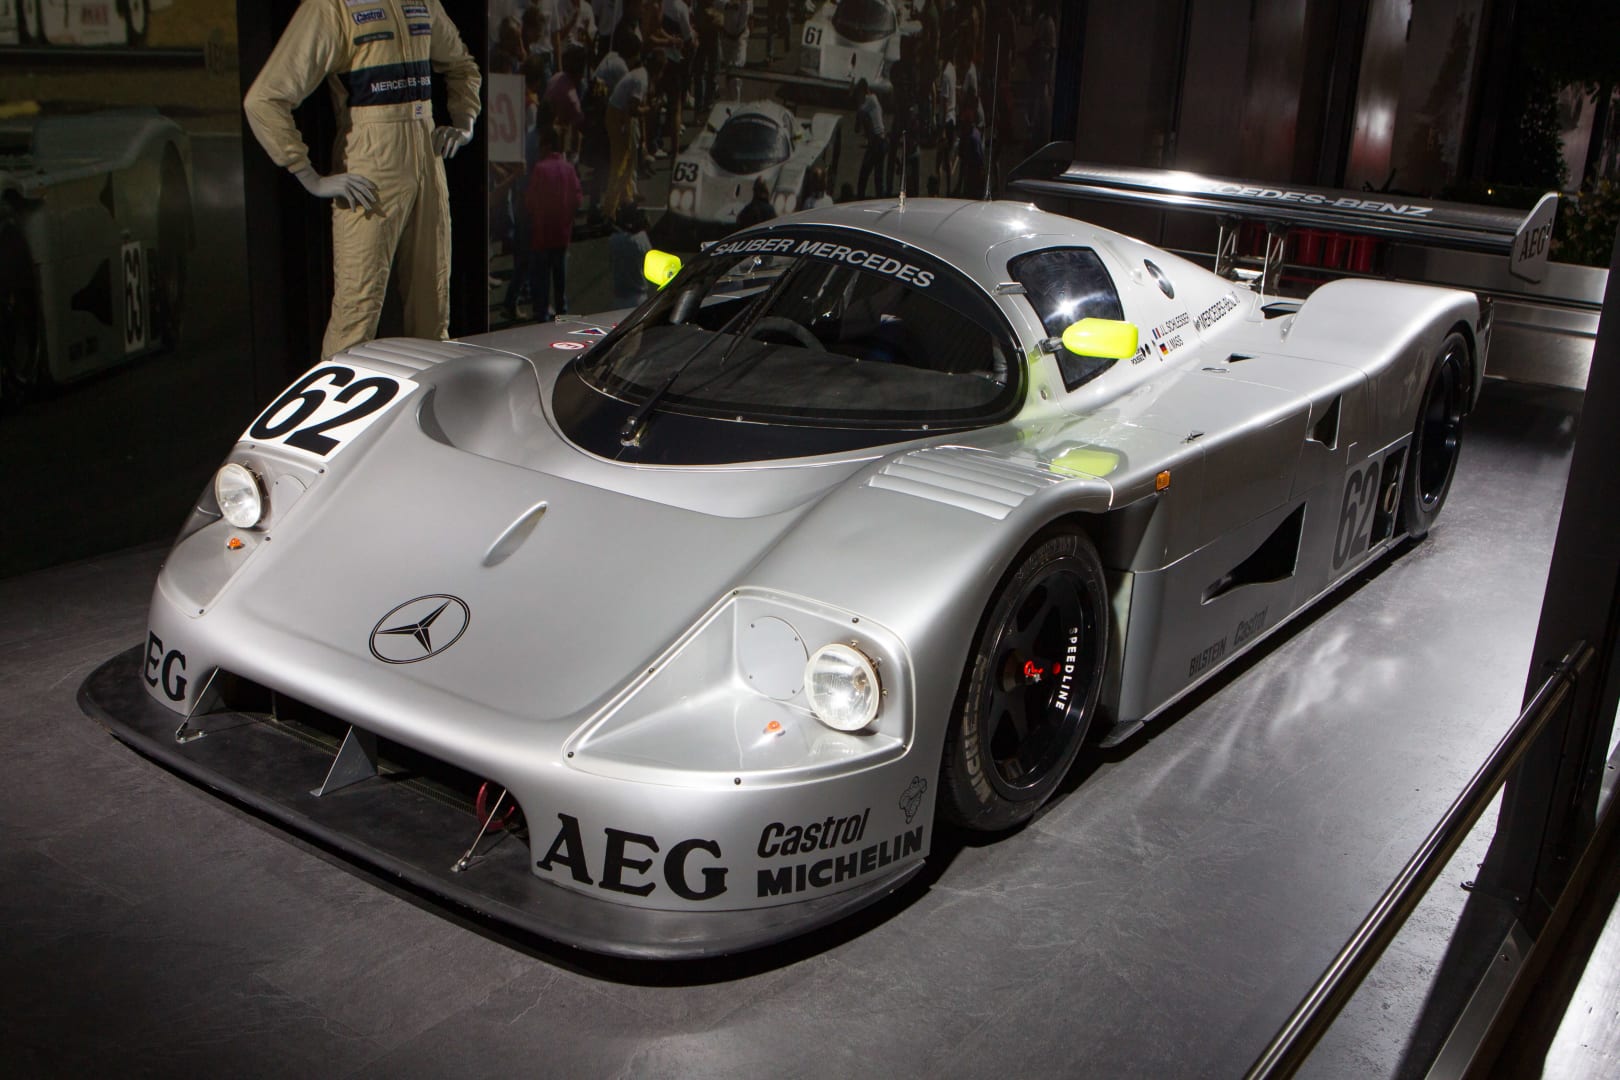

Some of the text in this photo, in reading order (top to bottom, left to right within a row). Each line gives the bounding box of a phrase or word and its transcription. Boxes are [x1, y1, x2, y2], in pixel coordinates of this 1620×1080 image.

[804, 26, 822, 45] 61
[675, 161, 698, 182] 63
[710, 239, 934, 288] SAUBER MERCEDES
[1519, 227, 1547, 262] AEG
[249, 366, 400, 456] 62
[1332, 461, 1380, 570] 62
[1233, 606, 1268, 646] Castrol
[144, 630, 187, 701] EG
[1055, 626, 1078, 711] SPEEDLINE
[1188, 636, 1227, 677] BILSTEIN
[536, 812, 728, 901] AEG
[757, 807, 871, 858] Castrol
[757, 826, 923, 898] MICHELIN
